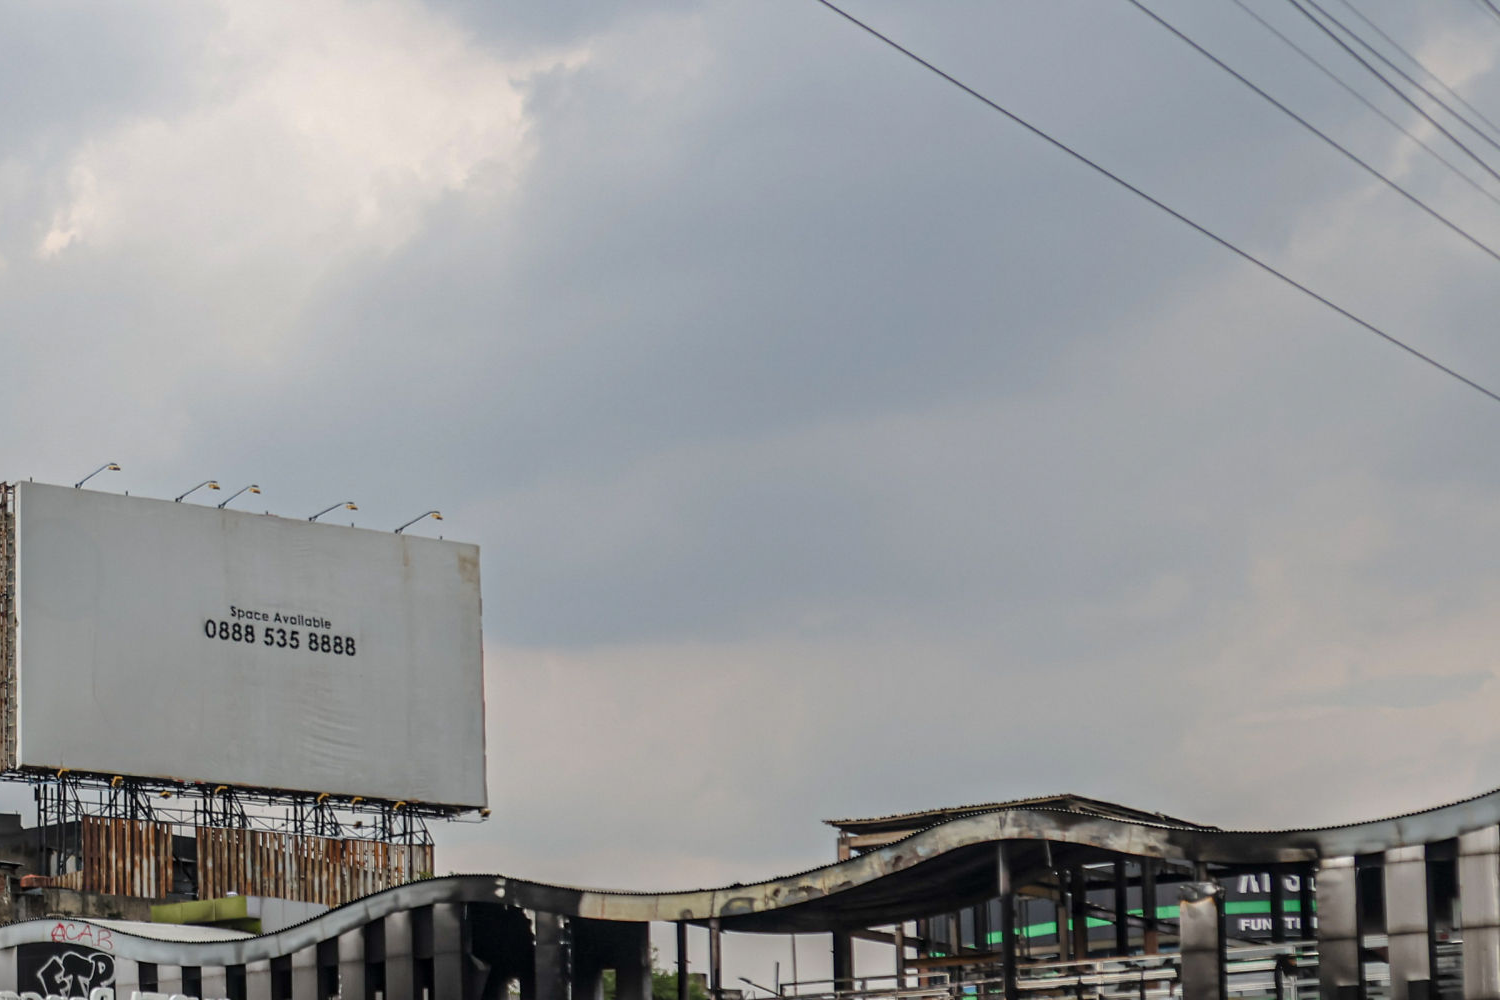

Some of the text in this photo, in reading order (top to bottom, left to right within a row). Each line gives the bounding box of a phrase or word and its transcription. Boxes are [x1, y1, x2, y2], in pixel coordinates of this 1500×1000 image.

[230, 606, 332, 630] Space Available
[205, 619, 356, 657] 0888 535 8888
[52, 922, 113, 950] ACAB
